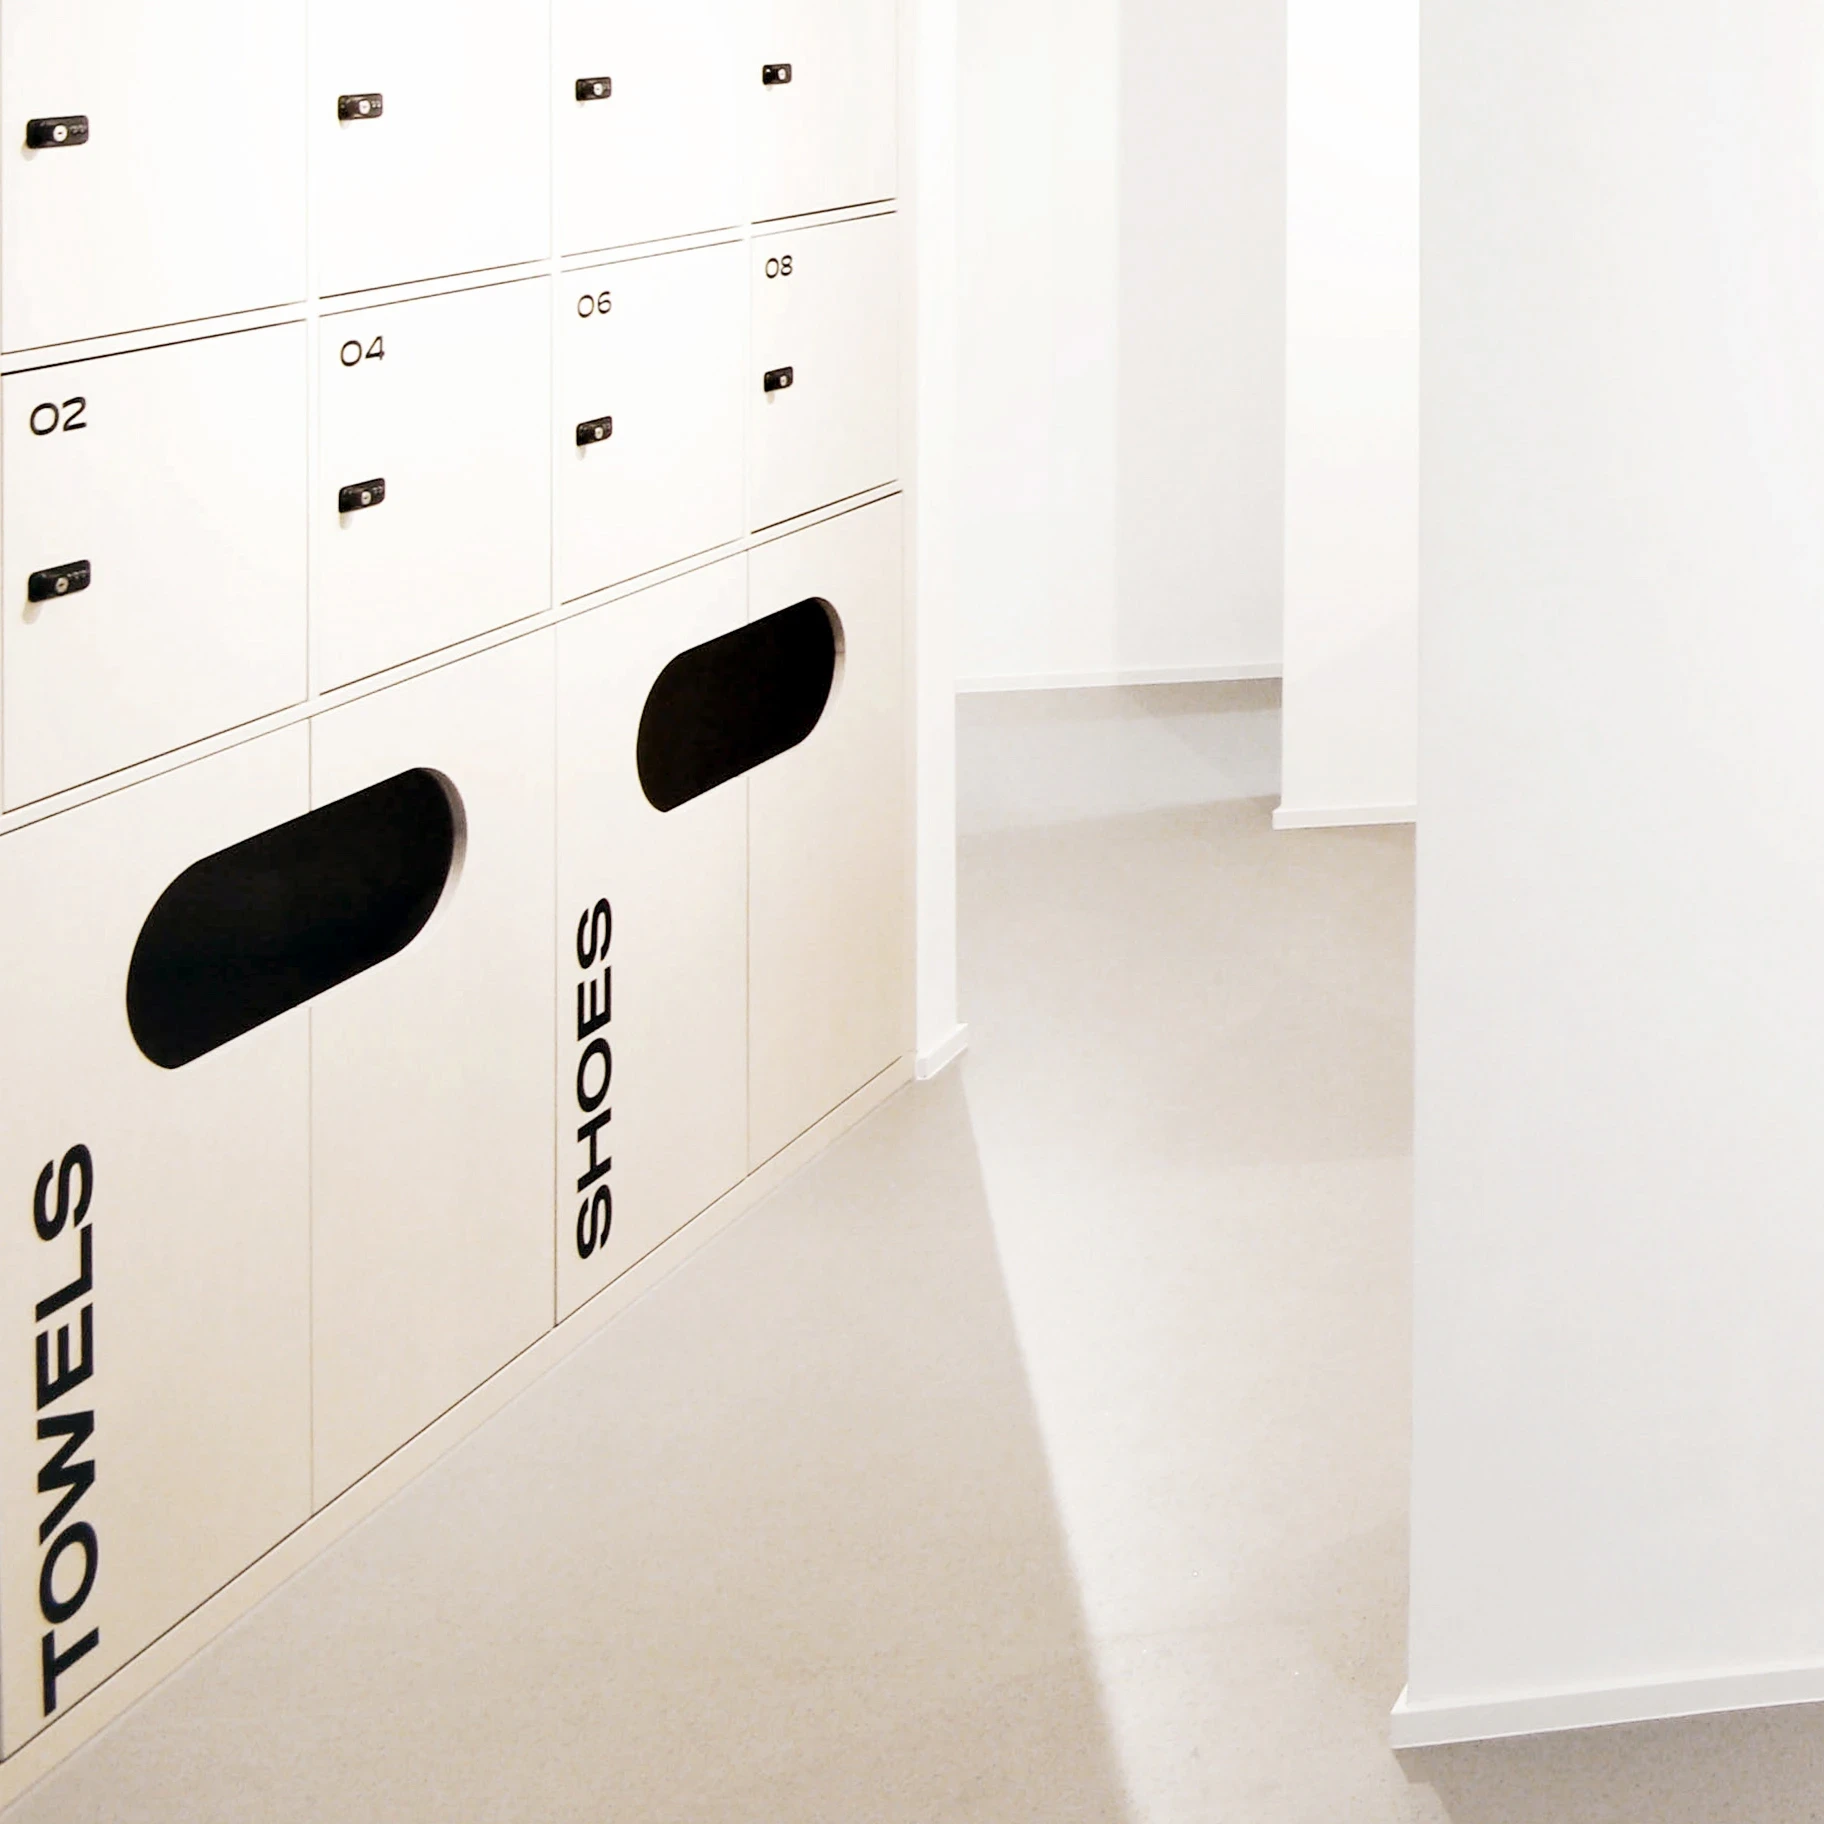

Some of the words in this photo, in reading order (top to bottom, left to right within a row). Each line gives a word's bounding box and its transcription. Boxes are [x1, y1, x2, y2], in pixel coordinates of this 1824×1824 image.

[764, 254, 793, 280] 08
[577, 290, 613, 319] 06
[340, 335, 386, 368] 04
[29, 396, 88, 437] 02
[576, 897, 612, 1260] SHOES
[34, 1143, 99, 1717] TOWELS
